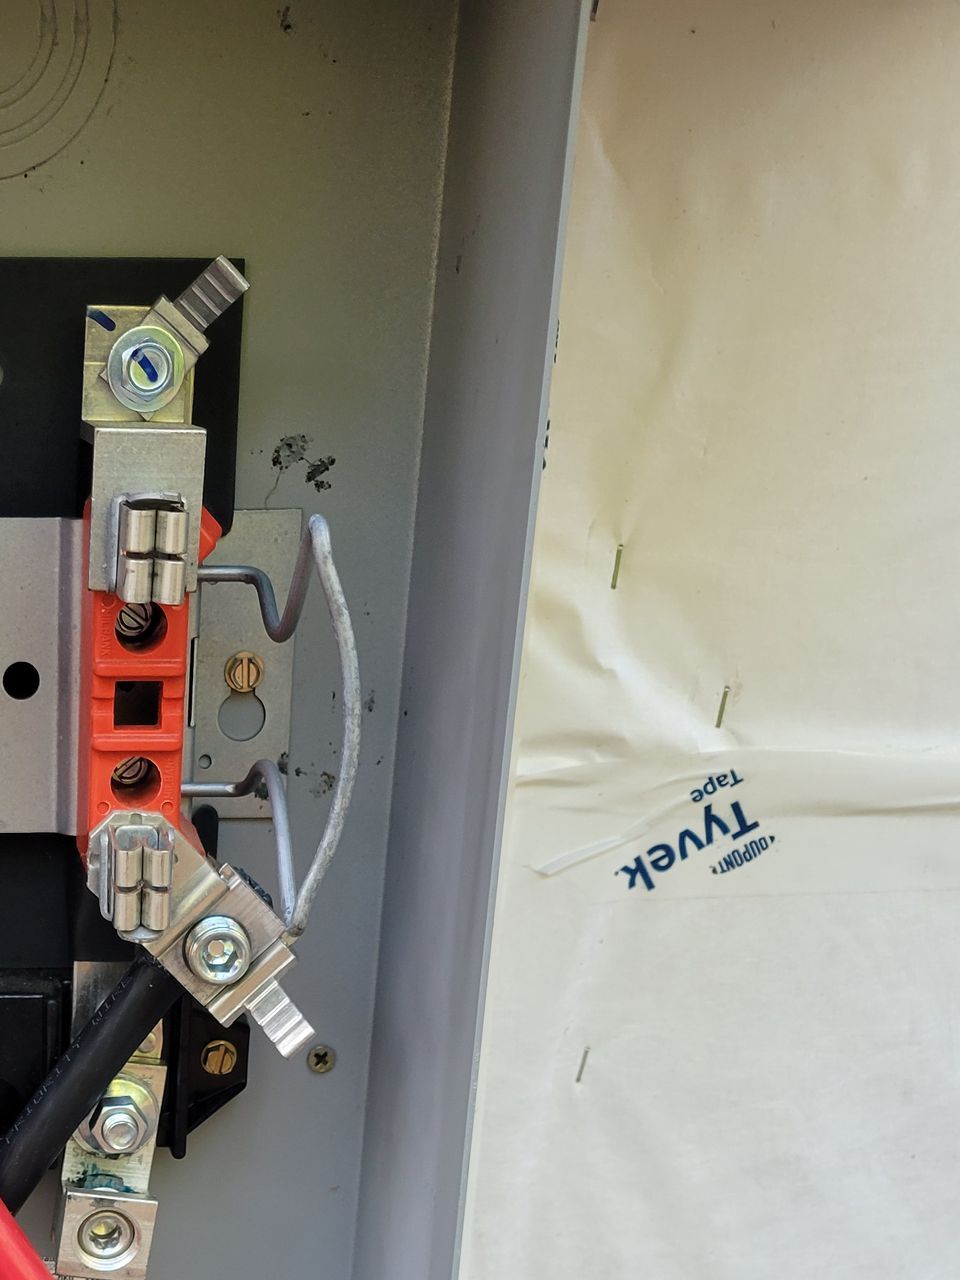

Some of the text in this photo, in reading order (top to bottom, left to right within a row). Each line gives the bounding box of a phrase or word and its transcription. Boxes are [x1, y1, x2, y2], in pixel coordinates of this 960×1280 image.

[689, 768, 745, 804] Tape
[619, 800, 760, 892] Tyvek
[716, 835, 770, 875] DUPONT
